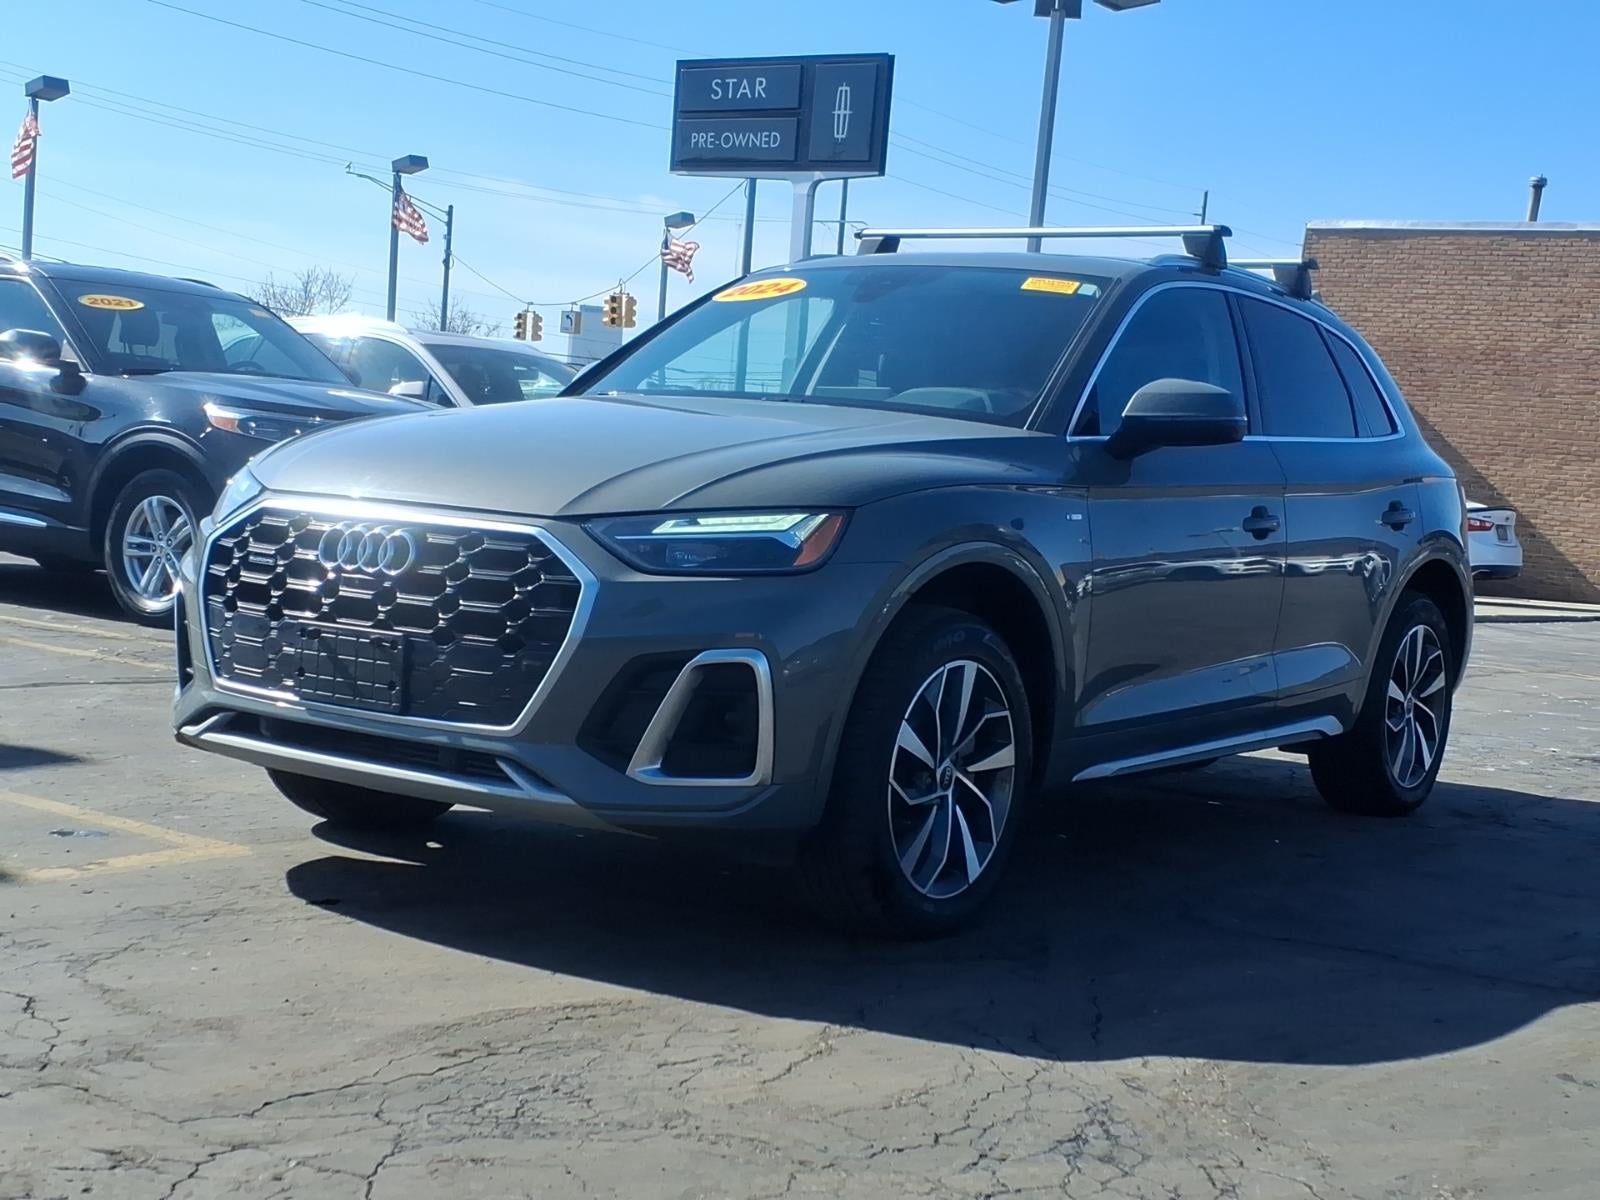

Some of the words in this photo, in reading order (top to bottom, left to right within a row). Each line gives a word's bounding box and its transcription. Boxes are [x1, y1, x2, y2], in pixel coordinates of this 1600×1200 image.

[711, 77, 767, 100] STAR
[691, 132, 780, 148] PRE-OWNED
[721, 282, 799, 298] 2024
[87, 297, 137, 307] 2021
